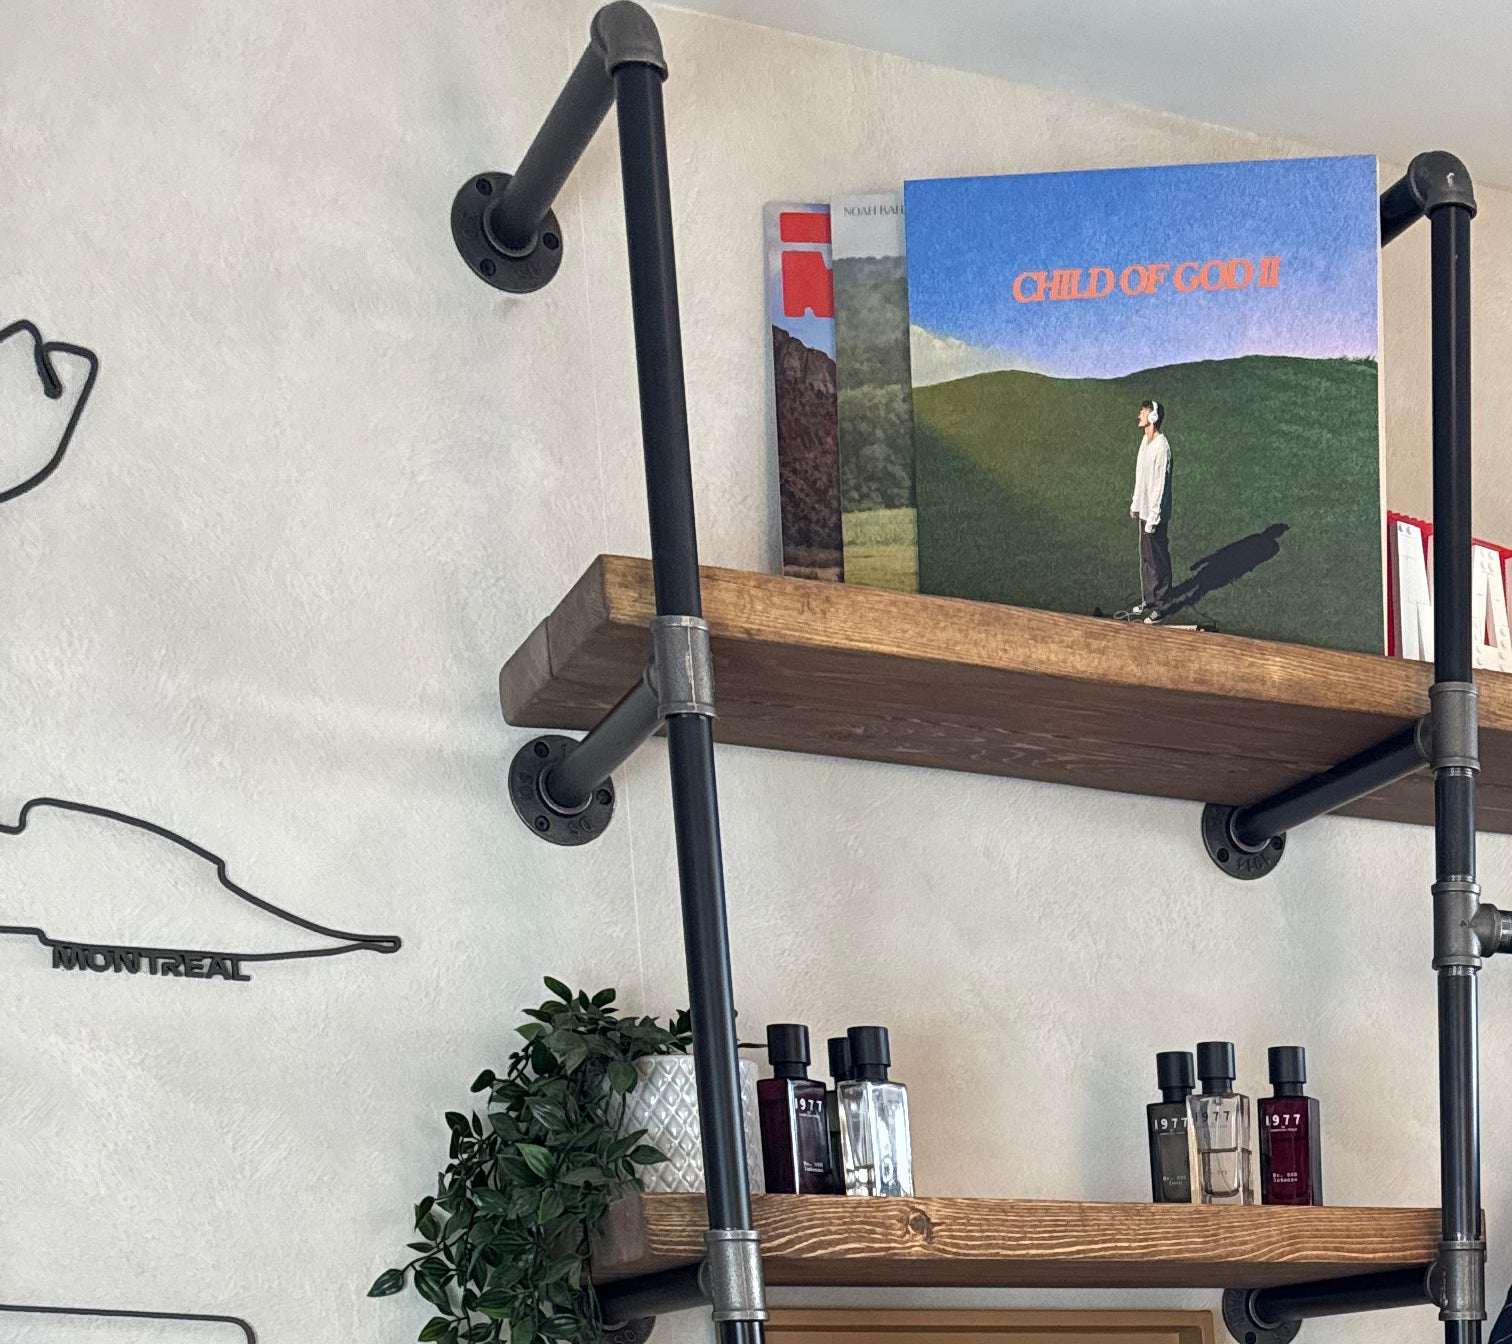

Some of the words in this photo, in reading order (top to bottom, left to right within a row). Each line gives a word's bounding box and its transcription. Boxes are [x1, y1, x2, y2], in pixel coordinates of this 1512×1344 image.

[843, 205, 877, 217] NOAH
[1012, 267, 1115, 304] CHILD
[1119, 263, 1170, 296] OF
[1173, 258, 1254, 293] GOD
[1256, 256, 1281, 288] II
[51, 945, 252, 982] MONTREAL
[794, 1097, 823, 1113] 1977
[1154, 1117, 1188, 1131] 1977
[1265, 1113, 1302, 1127] 1977
